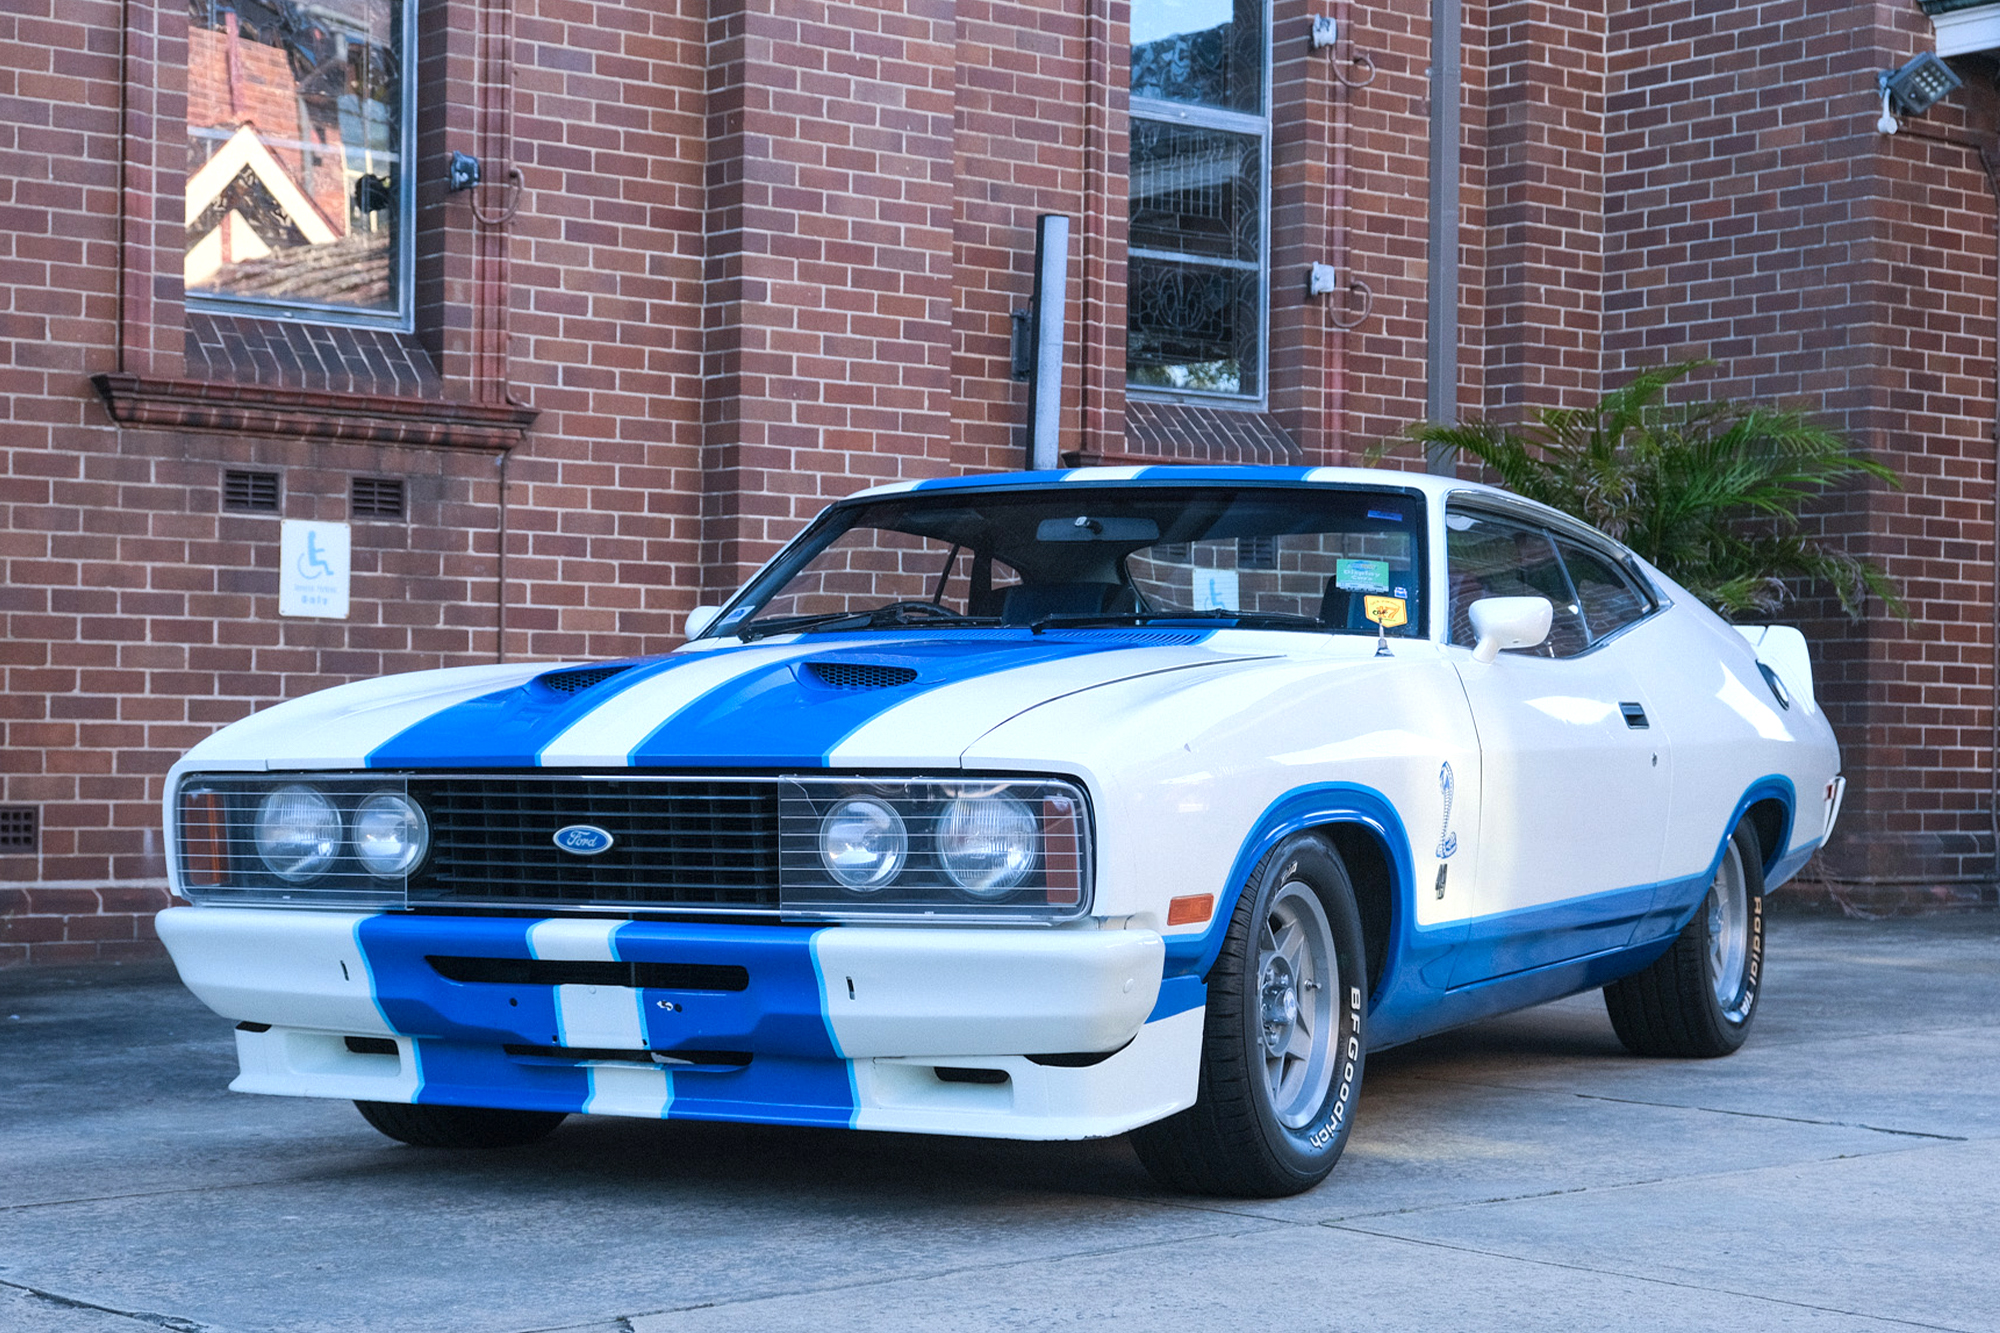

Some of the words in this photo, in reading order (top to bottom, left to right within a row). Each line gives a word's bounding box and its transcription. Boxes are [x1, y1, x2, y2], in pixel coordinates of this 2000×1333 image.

[1343, 568, 1381, 578] Display
[566, 830, 598, 848] Ford
[1749, 896, 1762, 986] Radial
[1309, 986, 1361, 1149] BFGoodrich
